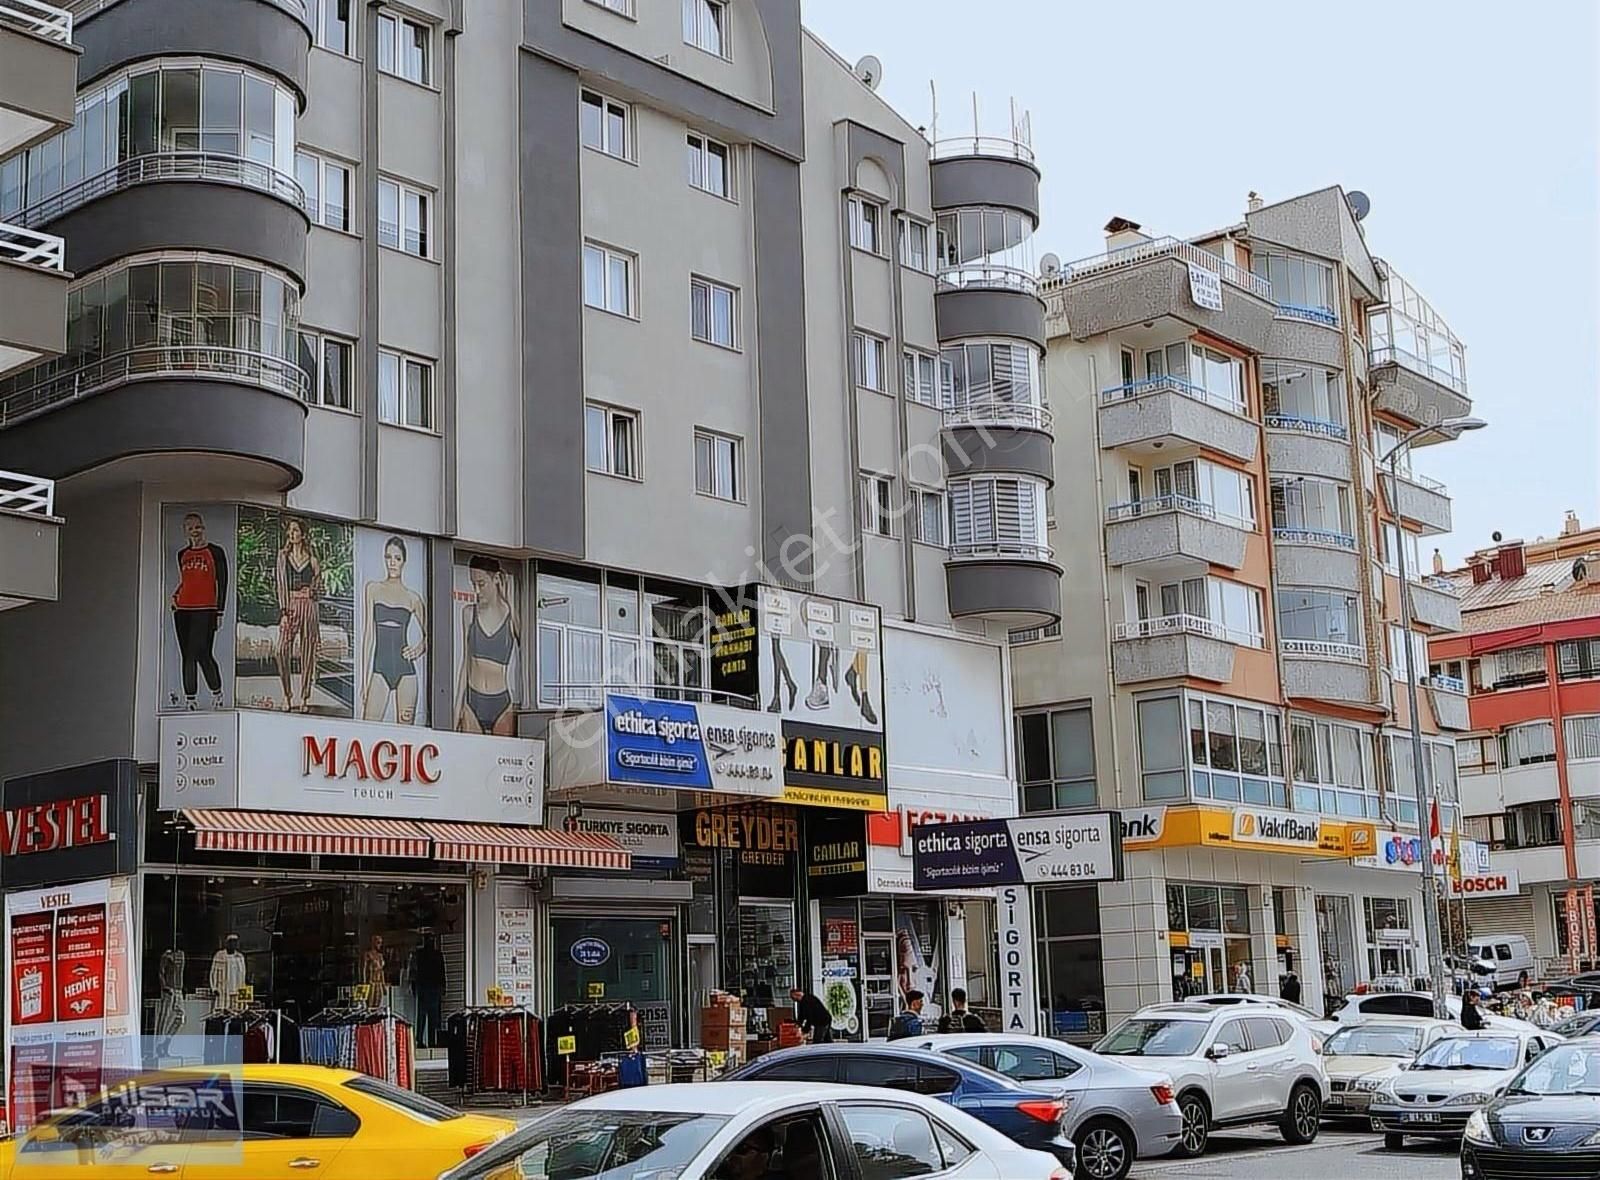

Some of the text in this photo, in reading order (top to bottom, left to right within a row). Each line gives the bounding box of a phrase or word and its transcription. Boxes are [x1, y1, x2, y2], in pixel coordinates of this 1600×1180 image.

[615, 710, 700, 744] ethica sigorta
[706, 726, 735, 744] ensa
[302, 736, 442, 784] MAGIC
[780, 737, 882, 779] ANLAR
[0, 794, 116, 856] VESTEL
[695, 812, 799, 851] GREYDER
[1017, 825, 1100, 850] ensa sigorta
[918, 831, 1008, 855] ethica sigorta
[742, 851, 785, 865] GREYDER
[1050, 863, 1096, 877] 444 83 04
[1452, 875, 1507, 894] BOSCH
[40, 892, 72, 909] VESTEL
[1569, 910, 1581, 973] BOSCH
[1003, 888, 1024, 1030] SİGORTA
[64, 975, 100, 999] HEDİYE
